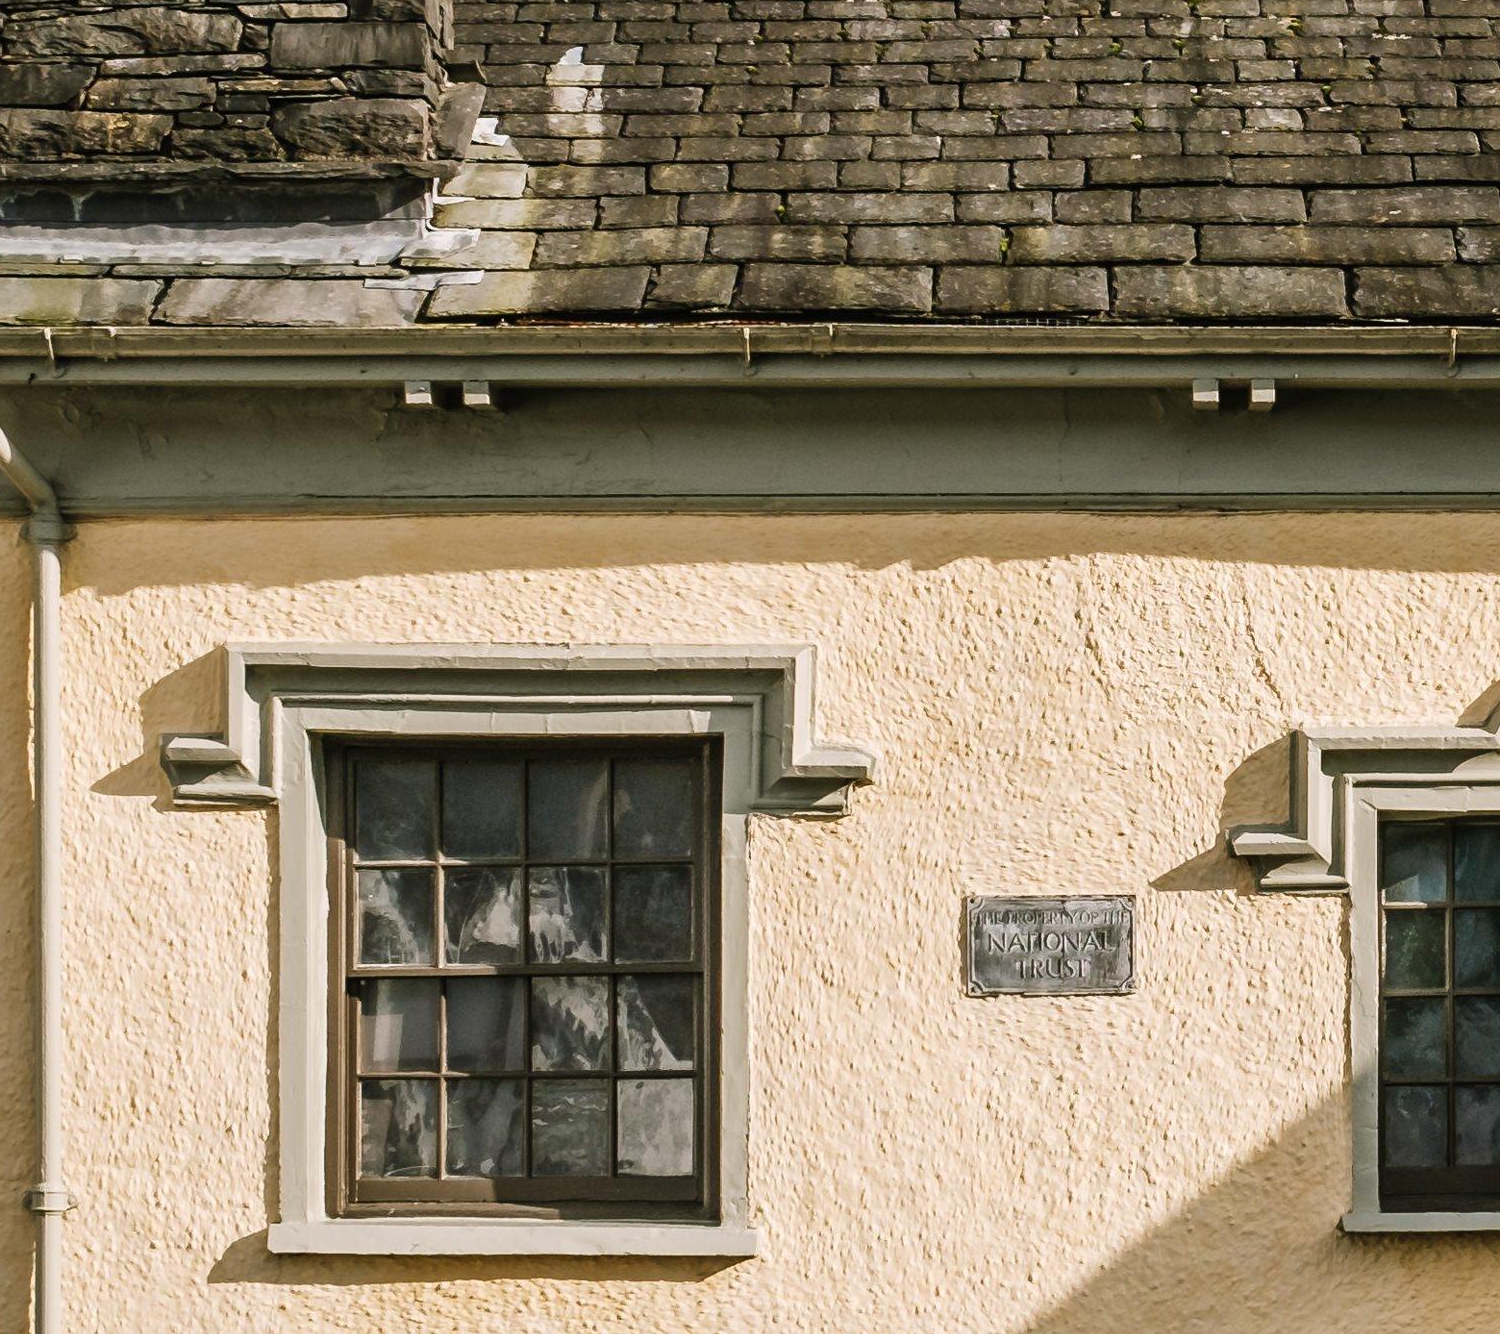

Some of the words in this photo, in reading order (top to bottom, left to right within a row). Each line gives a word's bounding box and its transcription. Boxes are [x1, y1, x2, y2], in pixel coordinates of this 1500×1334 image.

[1006, 911, 1079, 925] PROPERTY
[988, 931, 1117, 954] NATIONAL
[1014, 958, 1092, 979] TRUST
